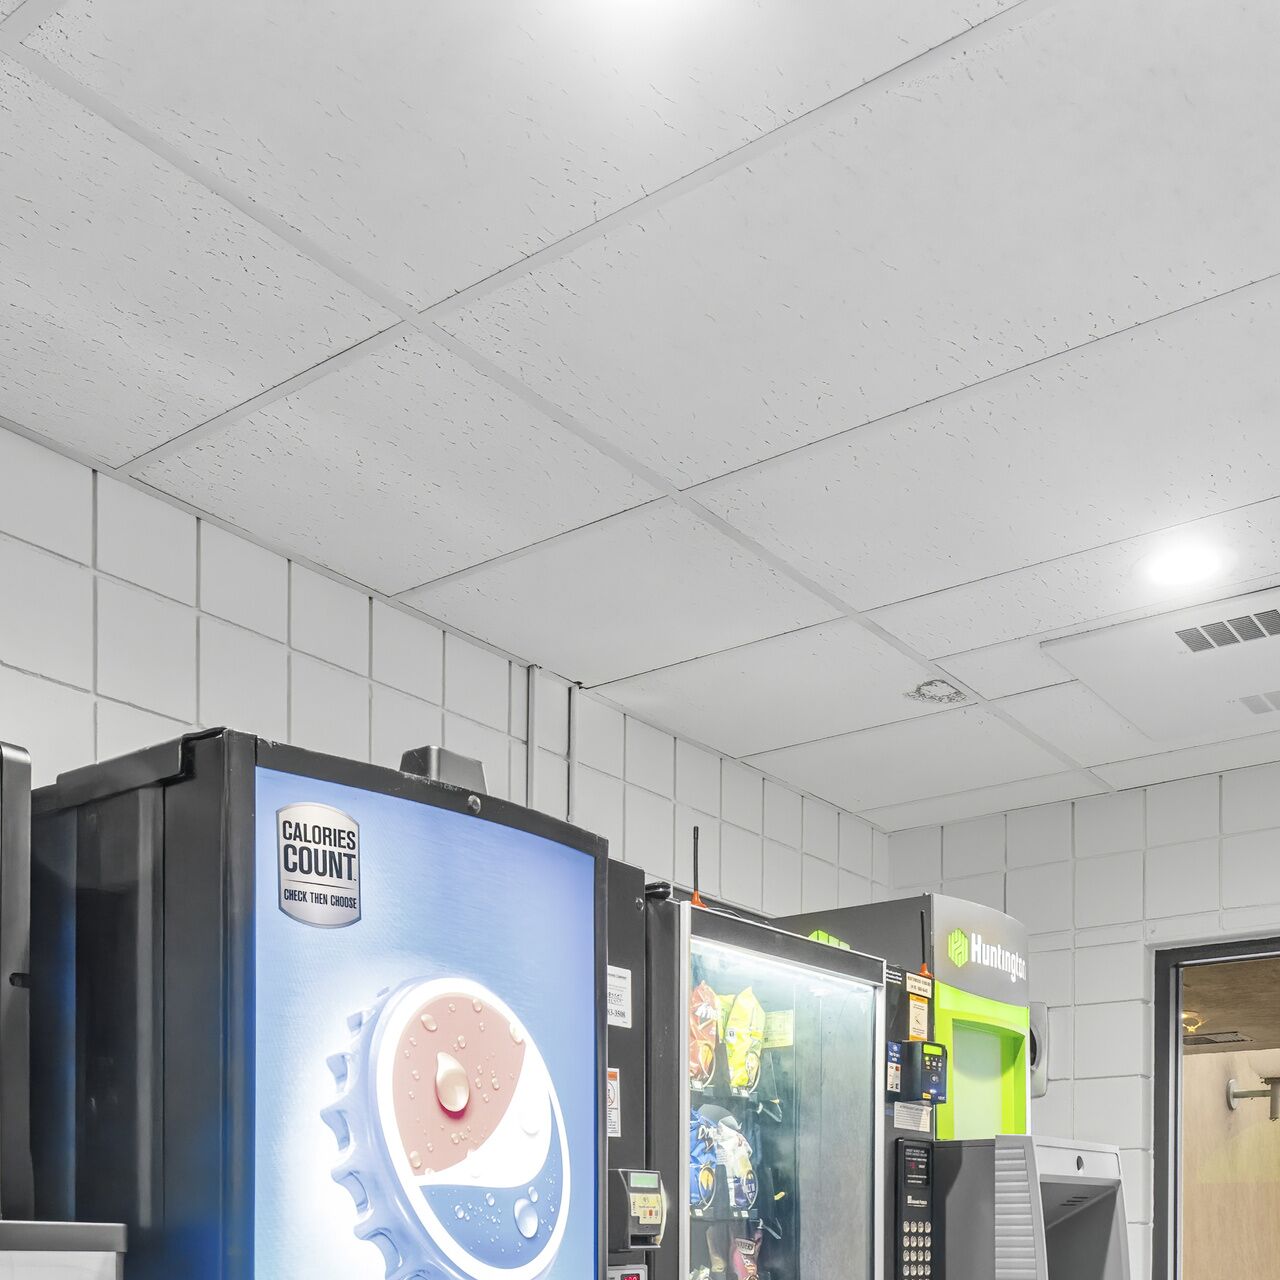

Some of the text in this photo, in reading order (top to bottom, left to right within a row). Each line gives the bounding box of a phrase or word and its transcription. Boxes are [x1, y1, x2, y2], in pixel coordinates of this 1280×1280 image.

[282, 820, 356, 850] CALORIES
[283, 888, 357, 909] CHECK THEN CHOOSE
[971, 932, 1027, 983] Huntington
